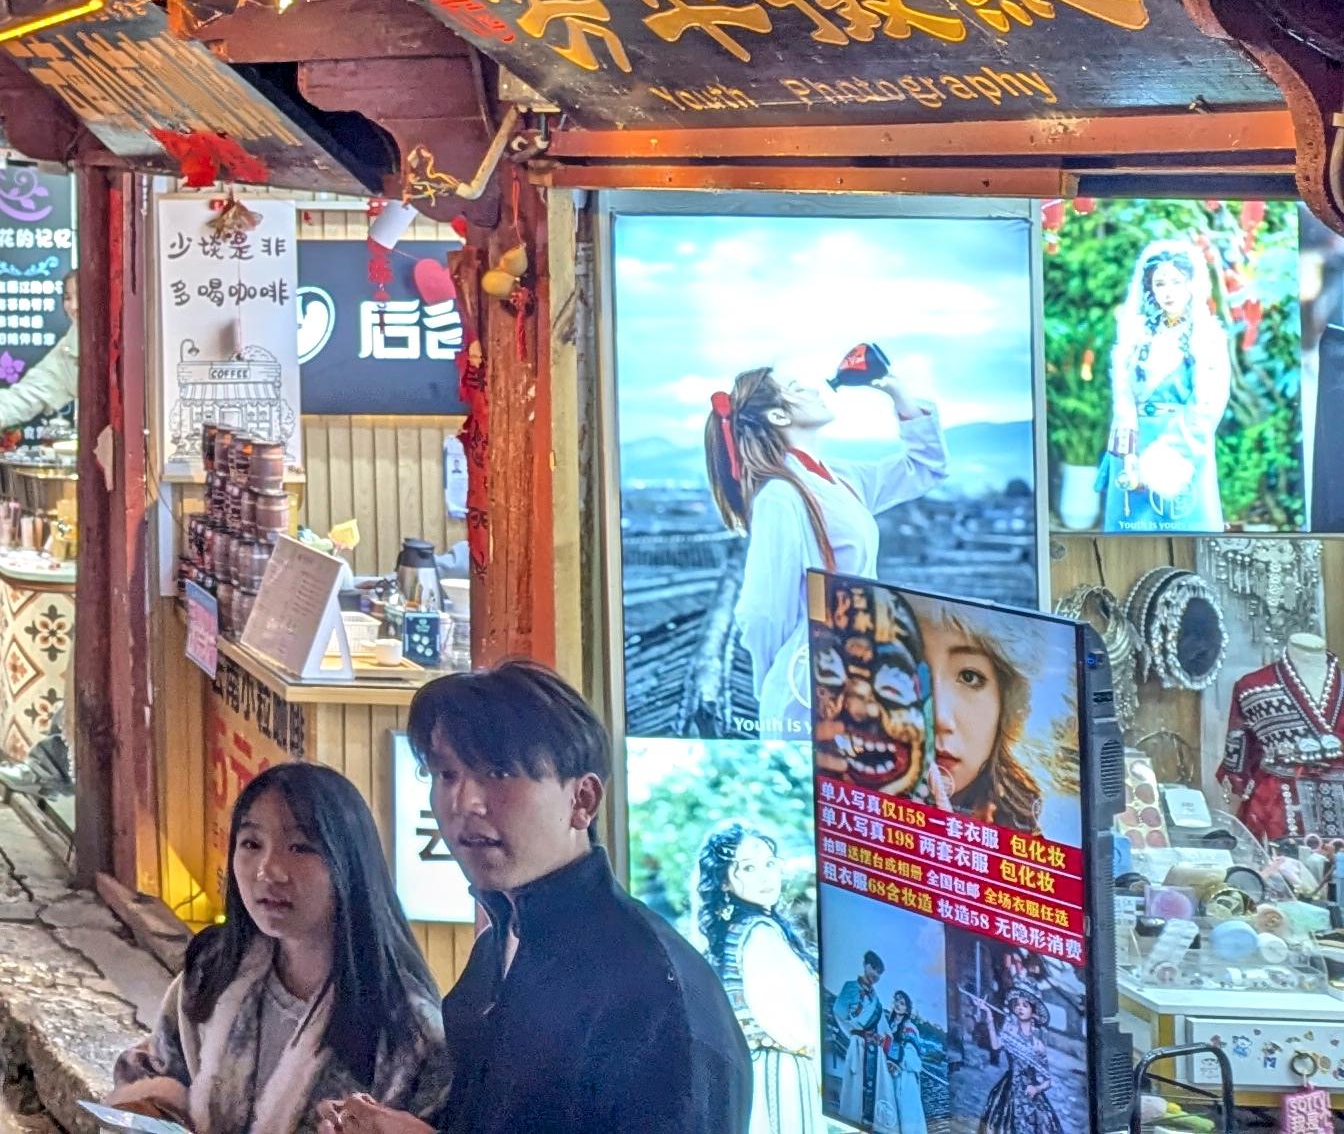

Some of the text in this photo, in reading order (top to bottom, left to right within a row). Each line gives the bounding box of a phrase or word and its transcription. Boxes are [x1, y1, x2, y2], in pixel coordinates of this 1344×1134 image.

[649, 66, 1058, 111] Youth Photography
[167, 231, 287, 261] 少谈是非
[170, 277, 290, 307] 多喝咖啡
[211, 369, 248, 379] COFFEE
[733, 716, 783, 733] Youth
[918, 834, 990, 875] 两套衣服
[999, 858, 1056, 894] 包化妆
[1009, 834, 1066, 870] 包化妆
[823, 861, 1083, 962] 租衣服68含妆造 妆造58 无隐形消费
[926, 869, 981, 900] 全国包邮
[983, 887, 1070, 928] 全场衣服任选
